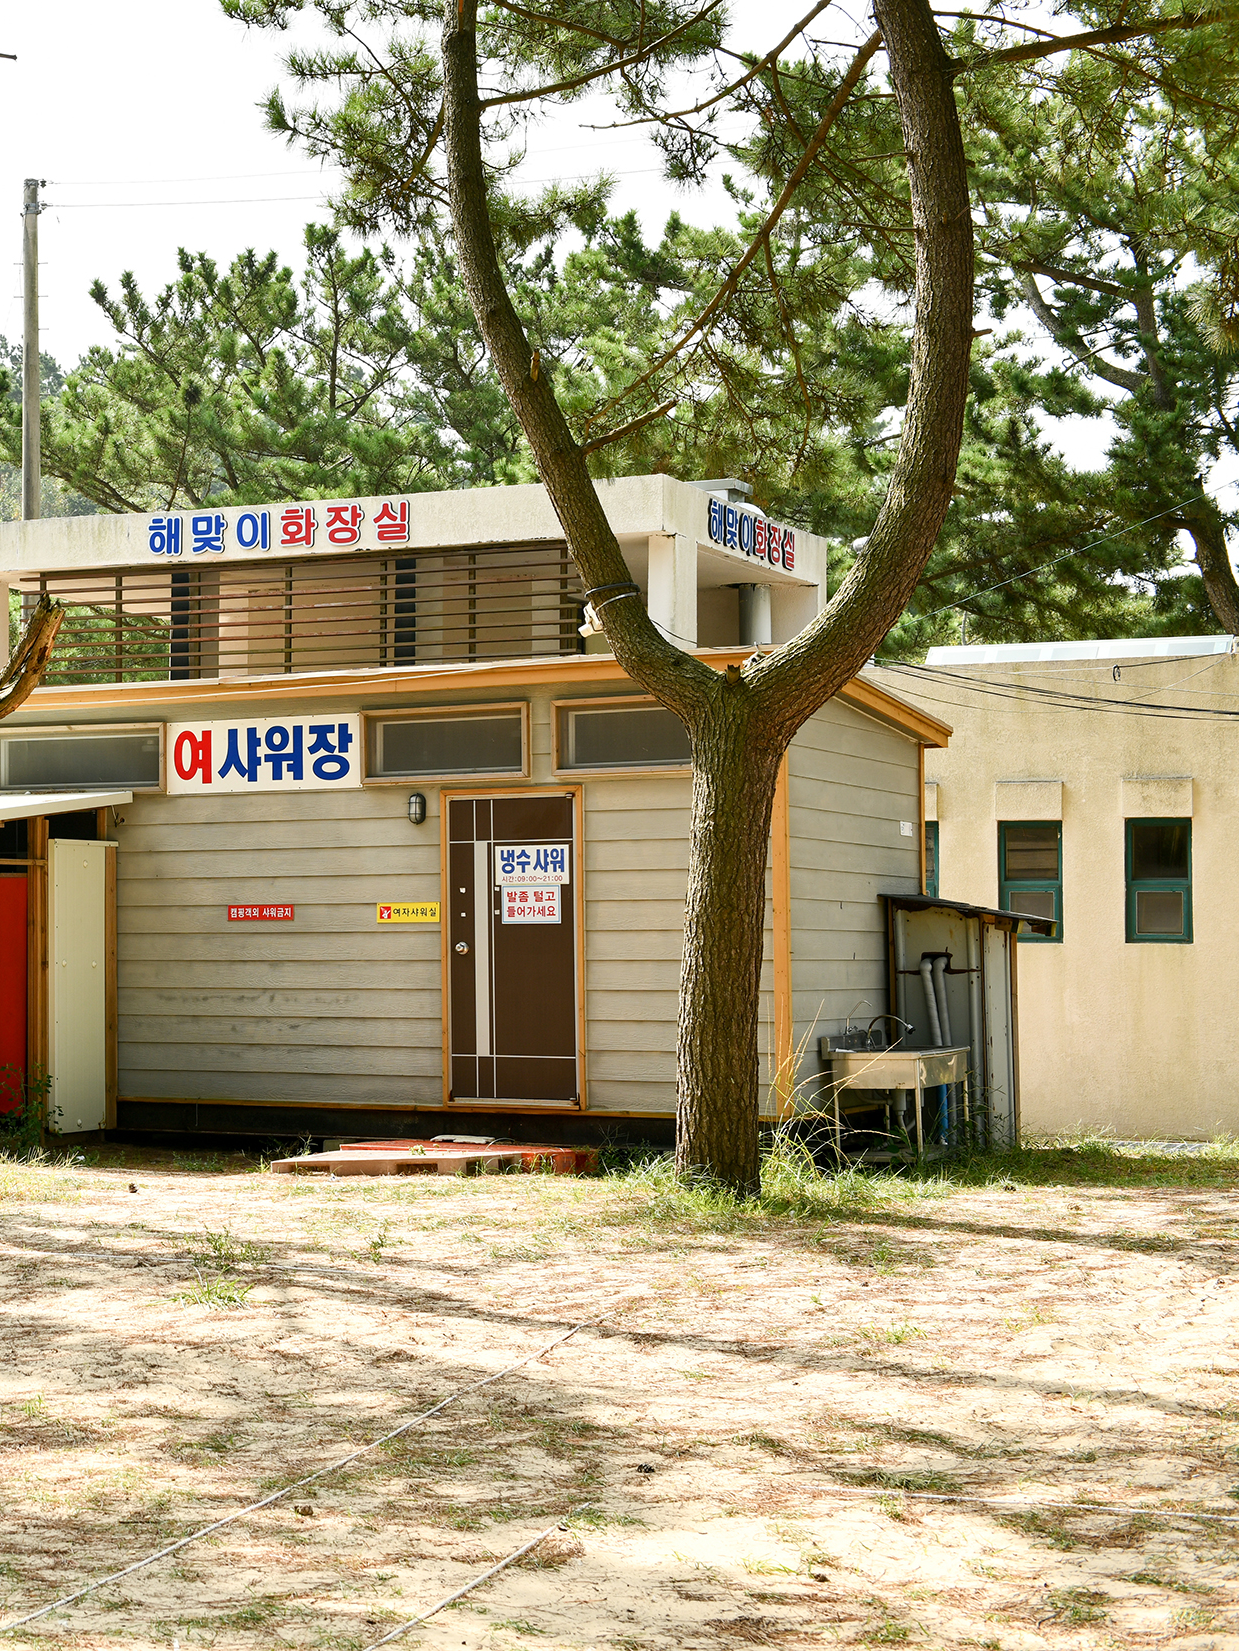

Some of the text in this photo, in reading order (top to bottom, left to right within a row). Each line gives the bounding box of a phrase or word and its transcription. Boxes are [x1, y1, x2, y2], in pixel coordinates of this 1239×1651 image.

[173, 722, 354, 784] 여샤워장
[500, 847, 565, 874] 냉수 샤워
[506, 890, 556, 903] 발좀 털고
[230, 907, 292, 918] 캠핑객외 샤워금지
[392, 907, 437, 917] 여자샤워실
[506, 905, 557, 918] 들어가세요
